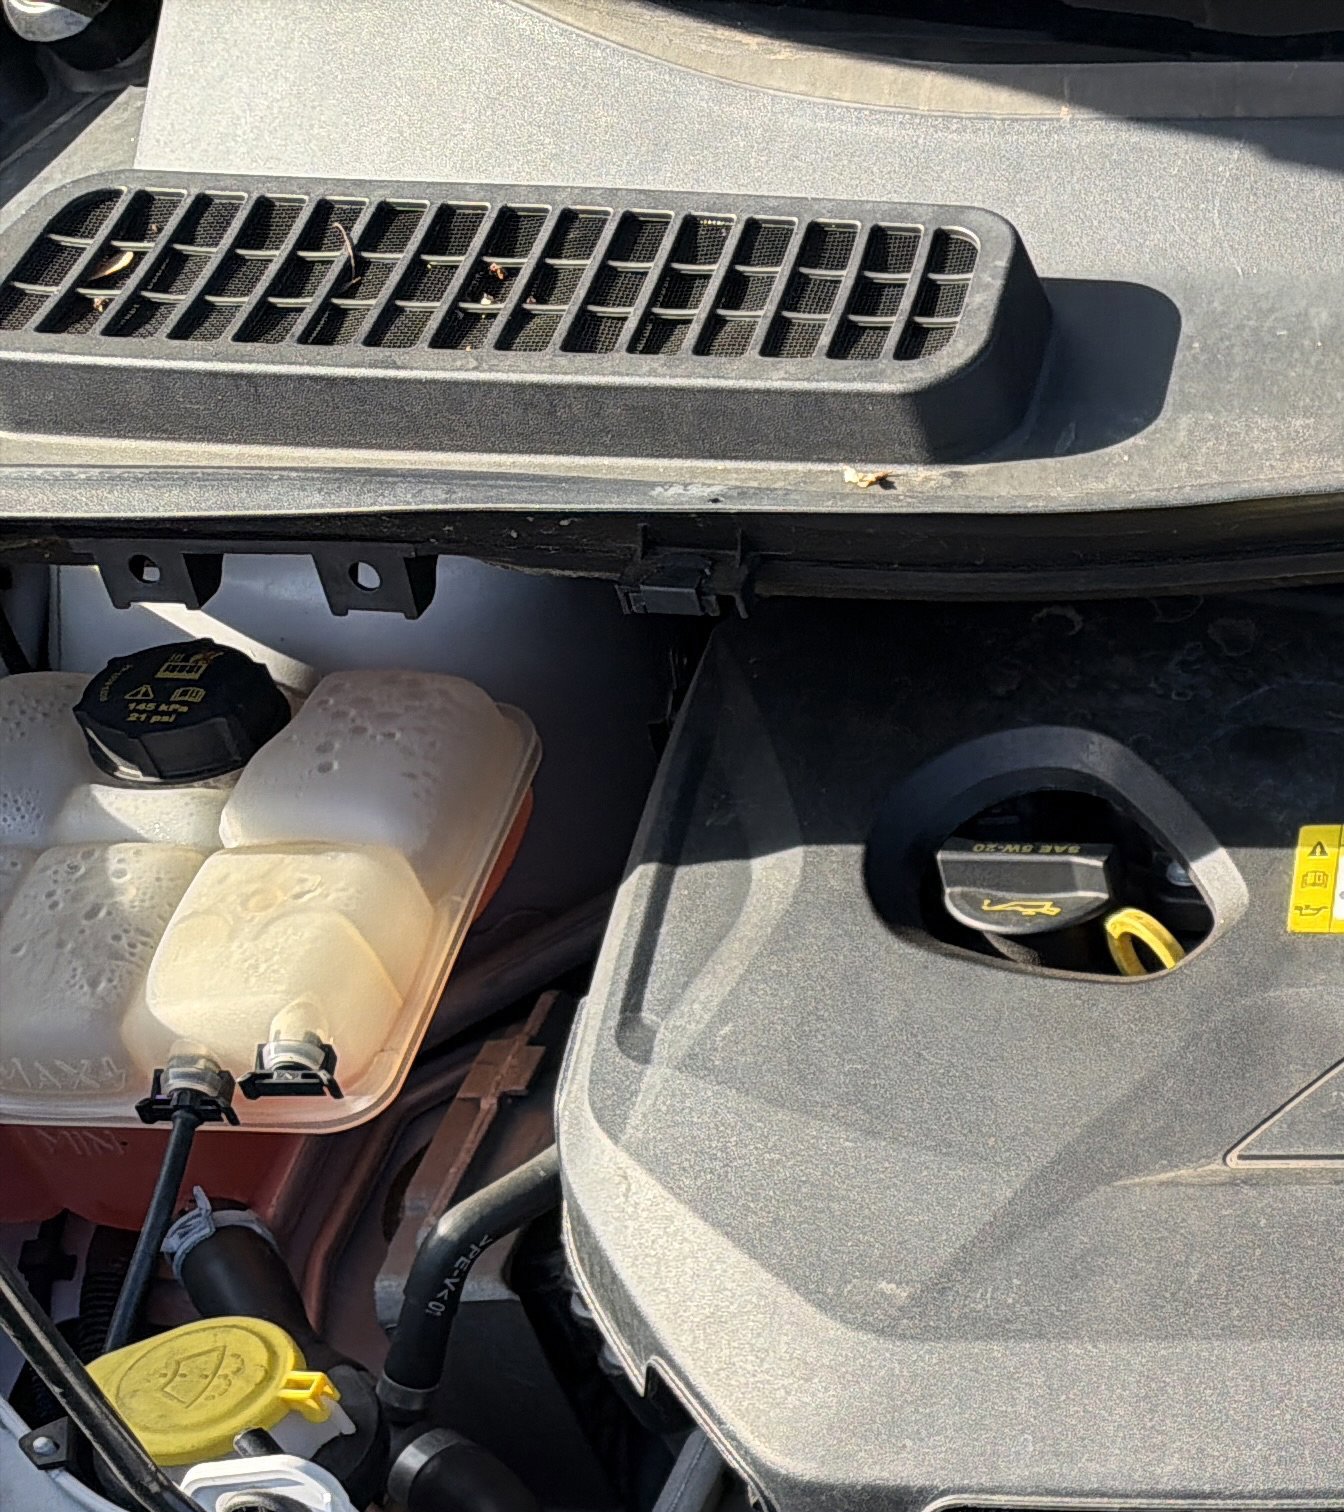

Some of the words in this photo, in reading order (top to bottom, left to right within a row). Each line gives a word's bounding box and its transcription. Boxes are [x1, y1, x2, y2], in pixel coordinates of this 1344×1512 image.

[127, 703, 156, 711] 145
[158, 702, 189, 712] kPa
[127, 713, 148, 722] 21
[150, 713, 176, 723] psi
[972, 843, 1037, 854] 5W-20
[1039, 844, 1081, 855] SAE
